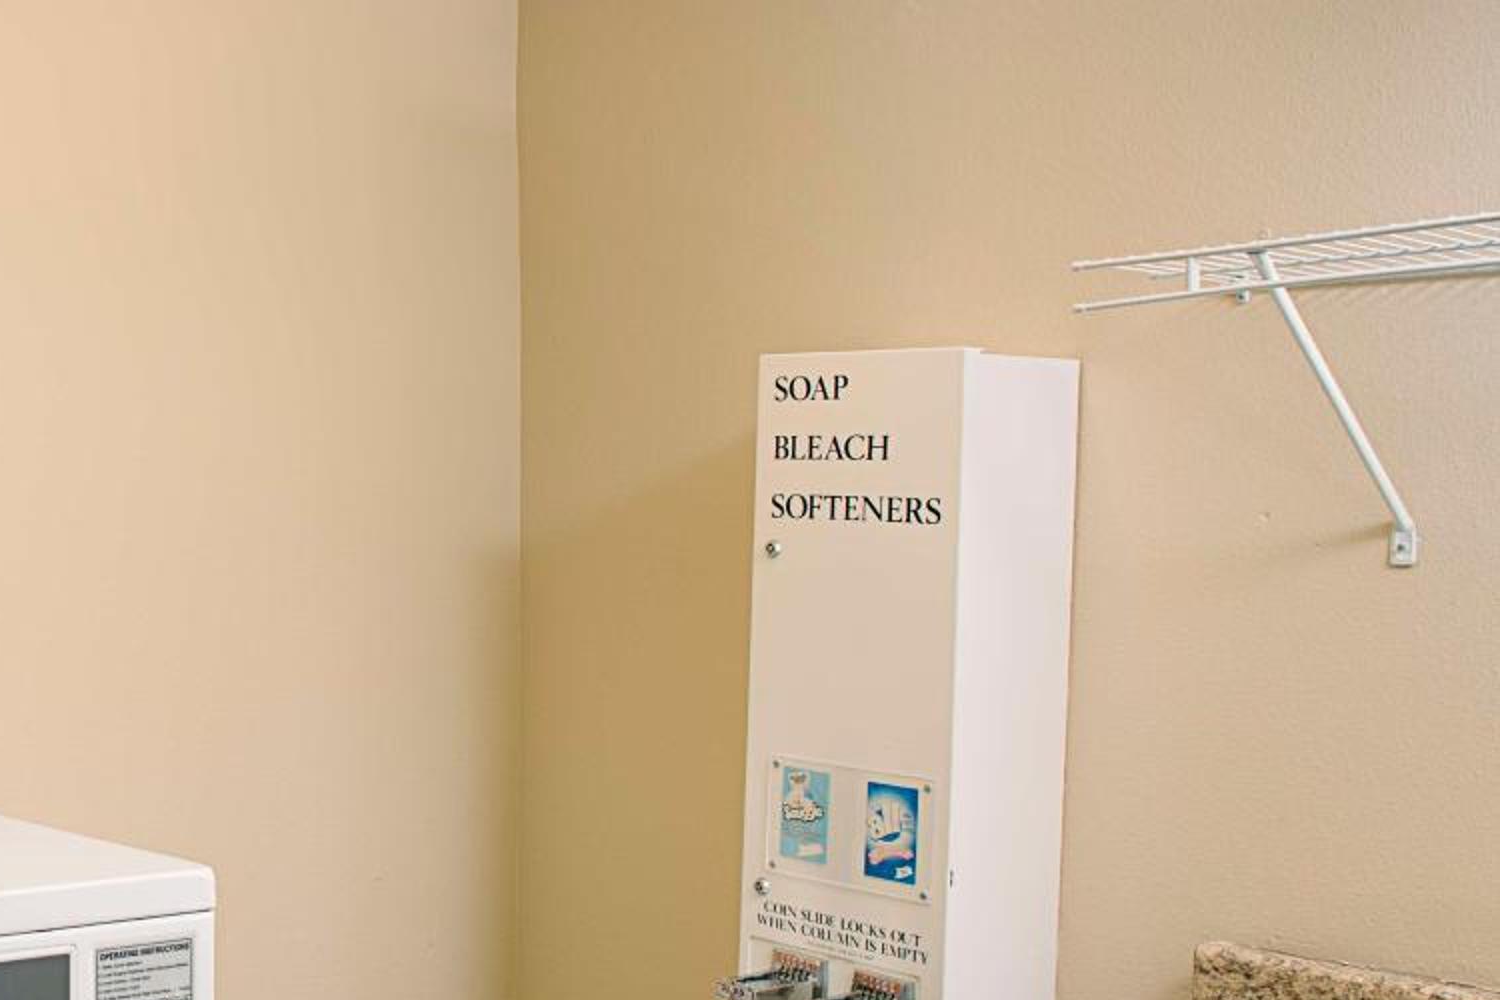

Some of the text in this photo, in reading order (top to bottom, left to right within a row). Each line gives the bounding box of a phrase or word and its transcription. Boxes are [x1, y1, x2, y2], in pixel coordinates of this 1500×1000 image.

[774, 375, 849, 402] SOAP
[774, 434, 890, 461] BLEACH
[771, 493, 942, 525] SOFTENERS
[757, 913, 797, 933] WHEN
[800, 925, 860, 948] COLUMN
[865, 939, 877, 953] IS
[881, 943, 928, 965] EMPTY
[763, 901, 922, 947] COIN SLIDE LOCKS OUT
